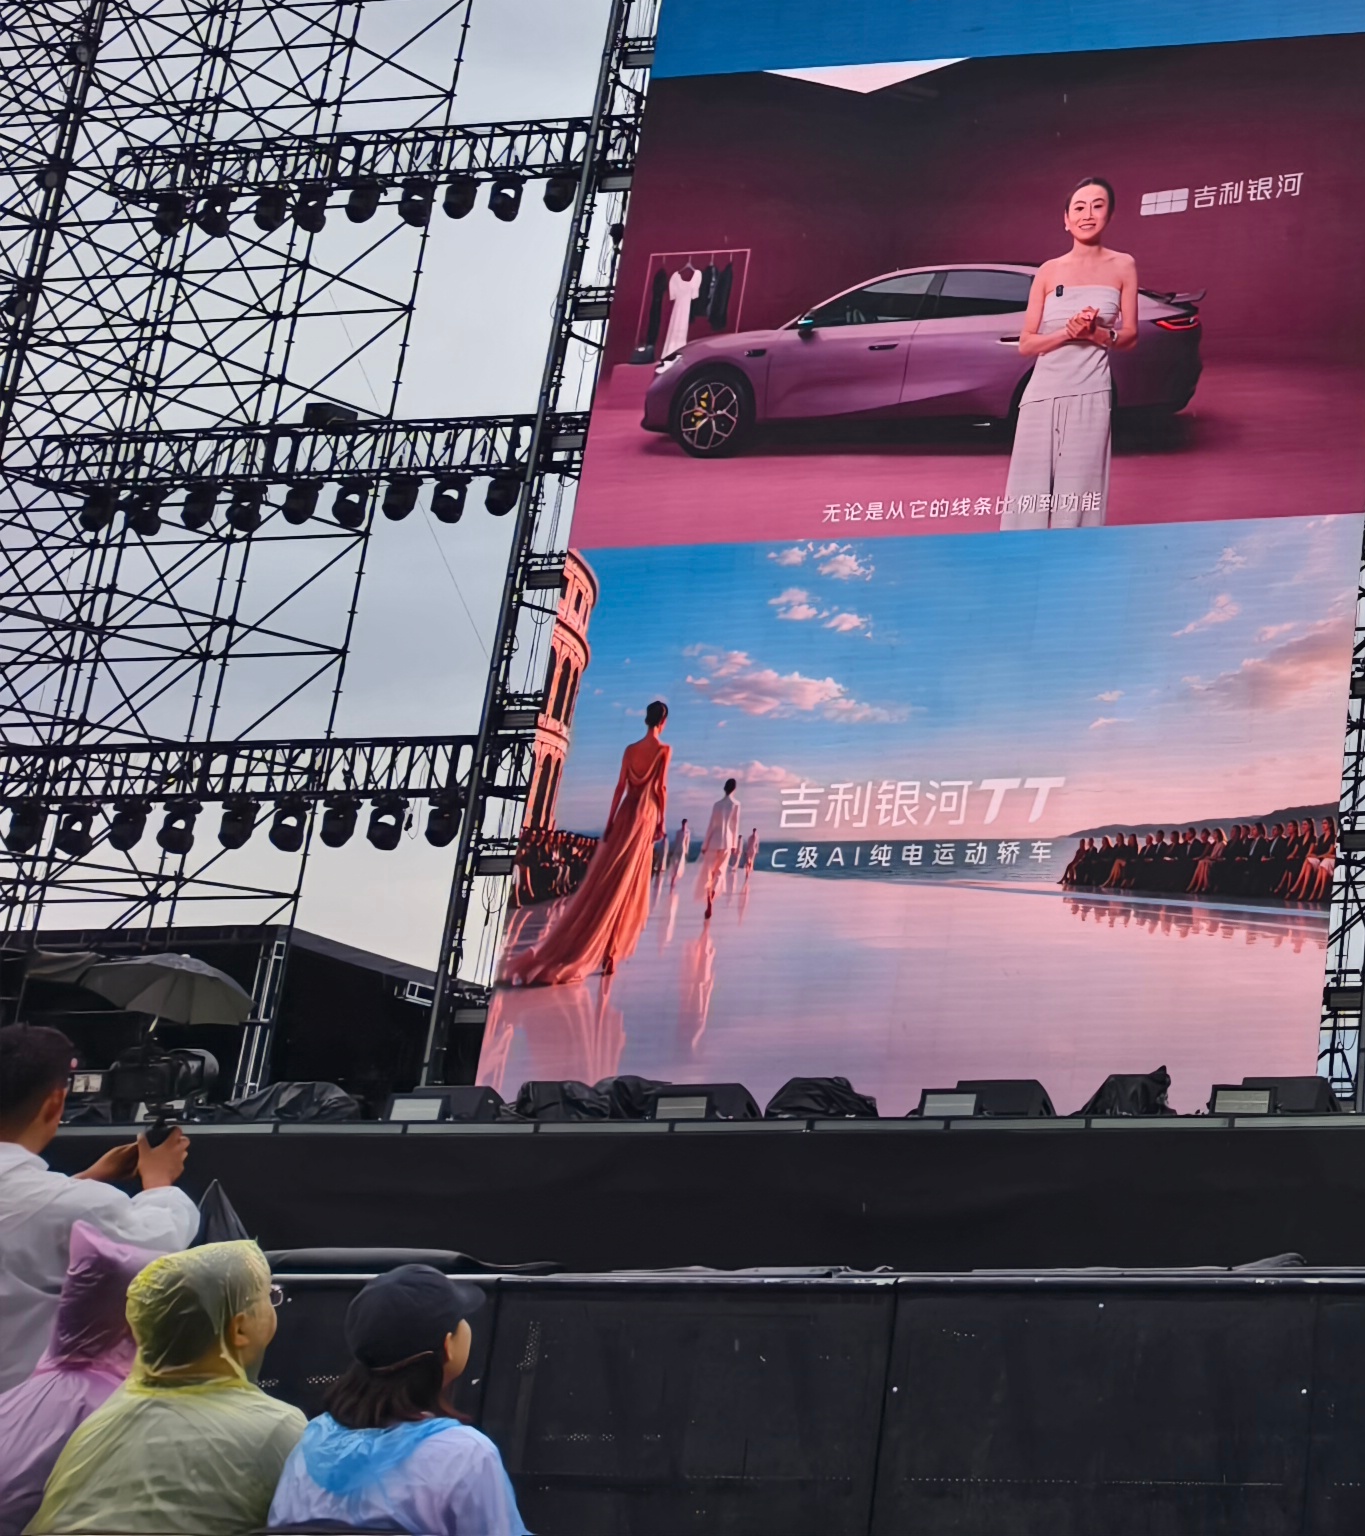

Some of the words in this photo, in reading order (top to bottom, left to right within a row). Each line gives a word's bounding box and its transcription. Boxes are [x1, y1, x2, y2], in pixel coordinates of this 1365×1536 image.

[1194, 172, 1304, 209] 吉利银河
[822, 490, 1102, 523] 无论是从它的线条比例到功能
[779, 776, 1066, 829] 吉利银河TT
